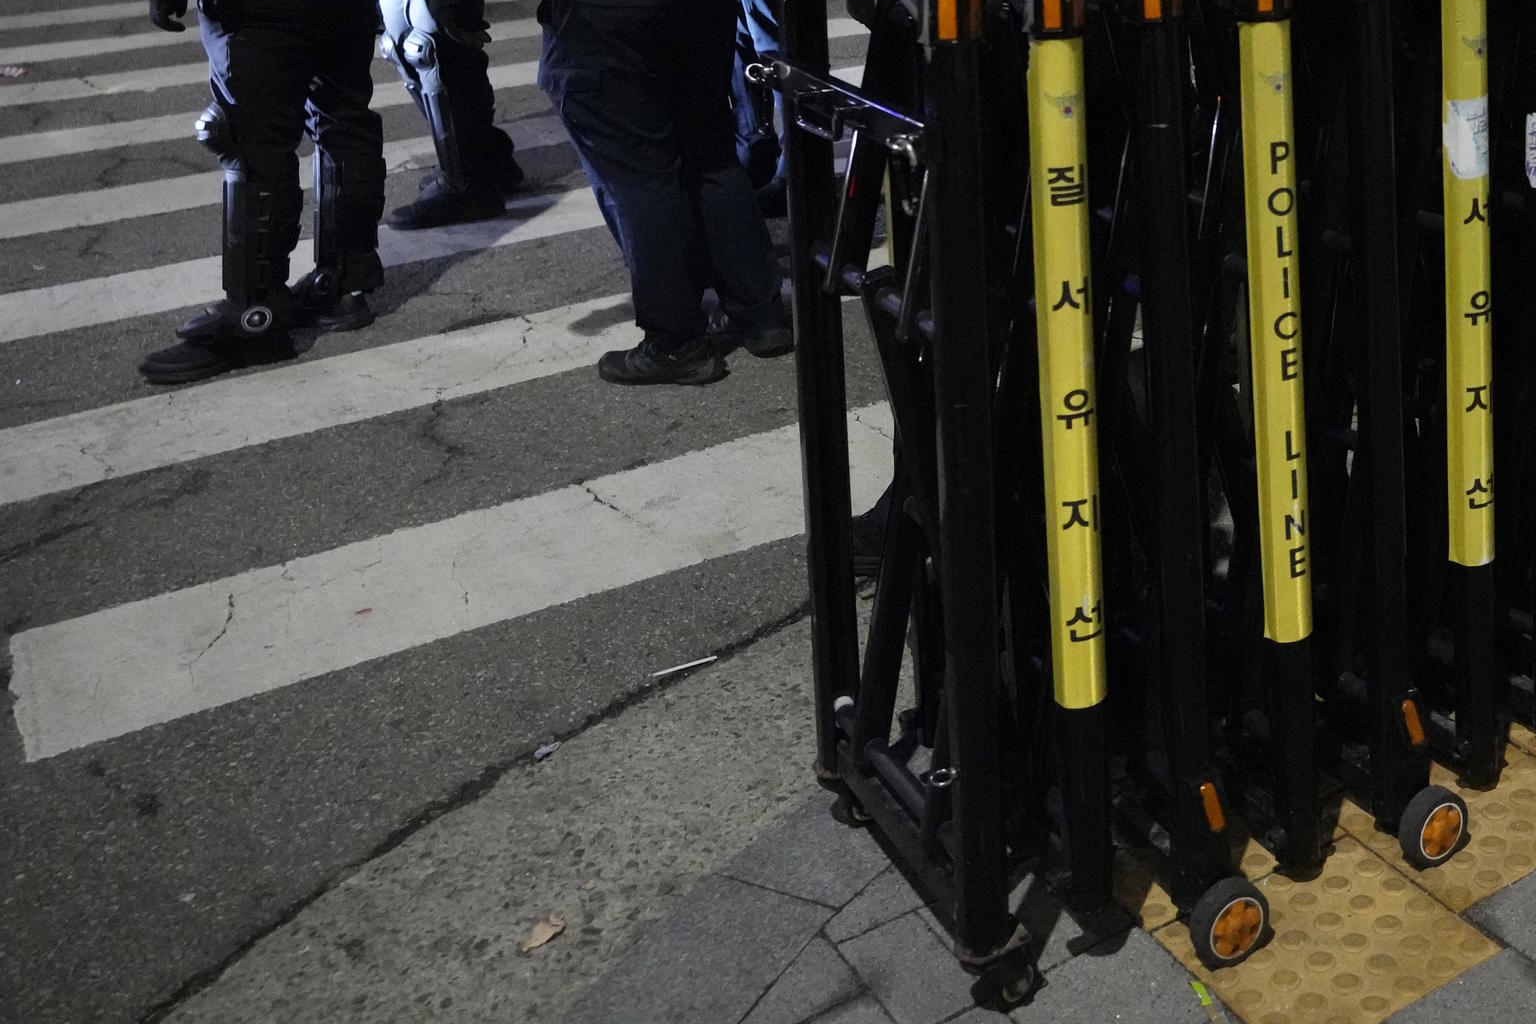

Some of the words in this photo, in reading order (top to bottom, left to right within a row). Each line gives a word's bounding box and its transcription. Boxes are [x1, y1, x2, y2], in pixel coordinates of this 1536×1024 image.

[1047, 164, 1103, 643] 질서유지선
[1268, 141, 1299, 382] POLICE
[1284, 430, 1306, 579] LINE
[1463, 194, 1496, 511] 서유지선
